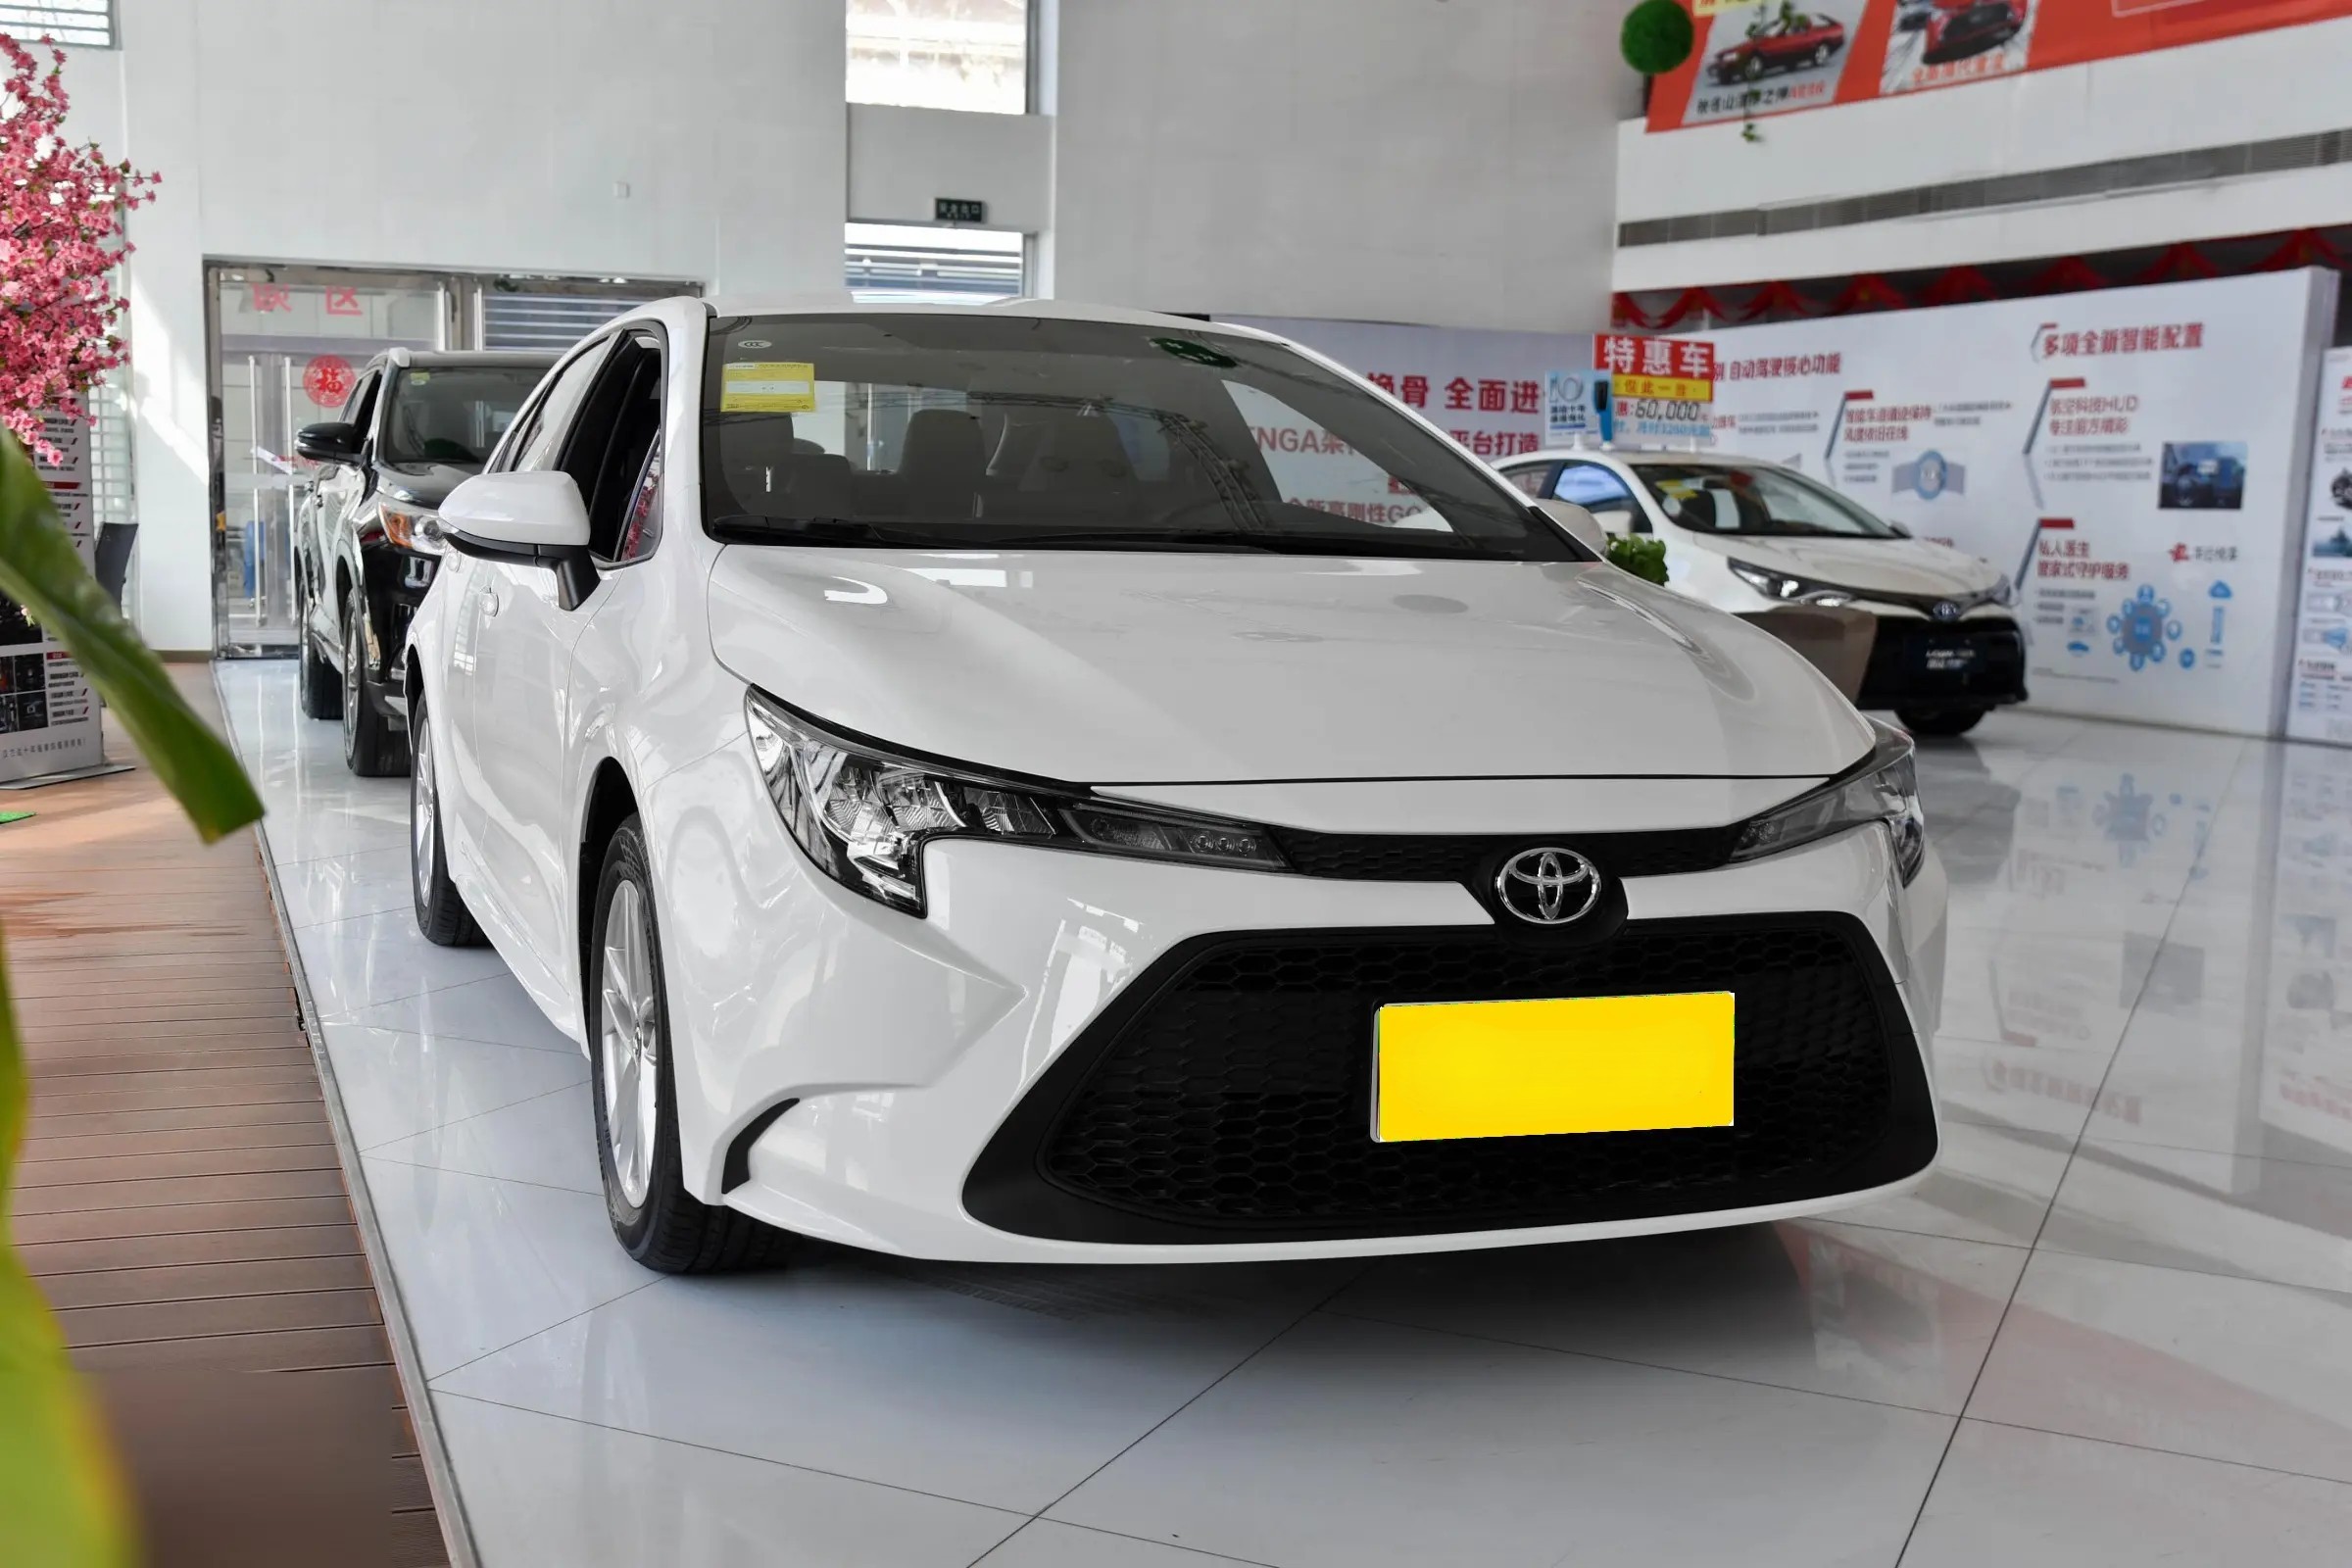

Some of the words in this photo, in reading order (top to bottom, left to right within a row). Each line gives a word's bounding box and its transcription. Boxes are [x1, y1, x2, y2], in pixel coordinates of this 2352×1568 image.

[1603, 336, 1711, 378] 特惠车
[2043, 322, 2204, 359] 多项全新智能配置
[1730, 352, 1841, 379] 自动驾驶核心功能
[1250, 426, 1355, 455] NGA架
